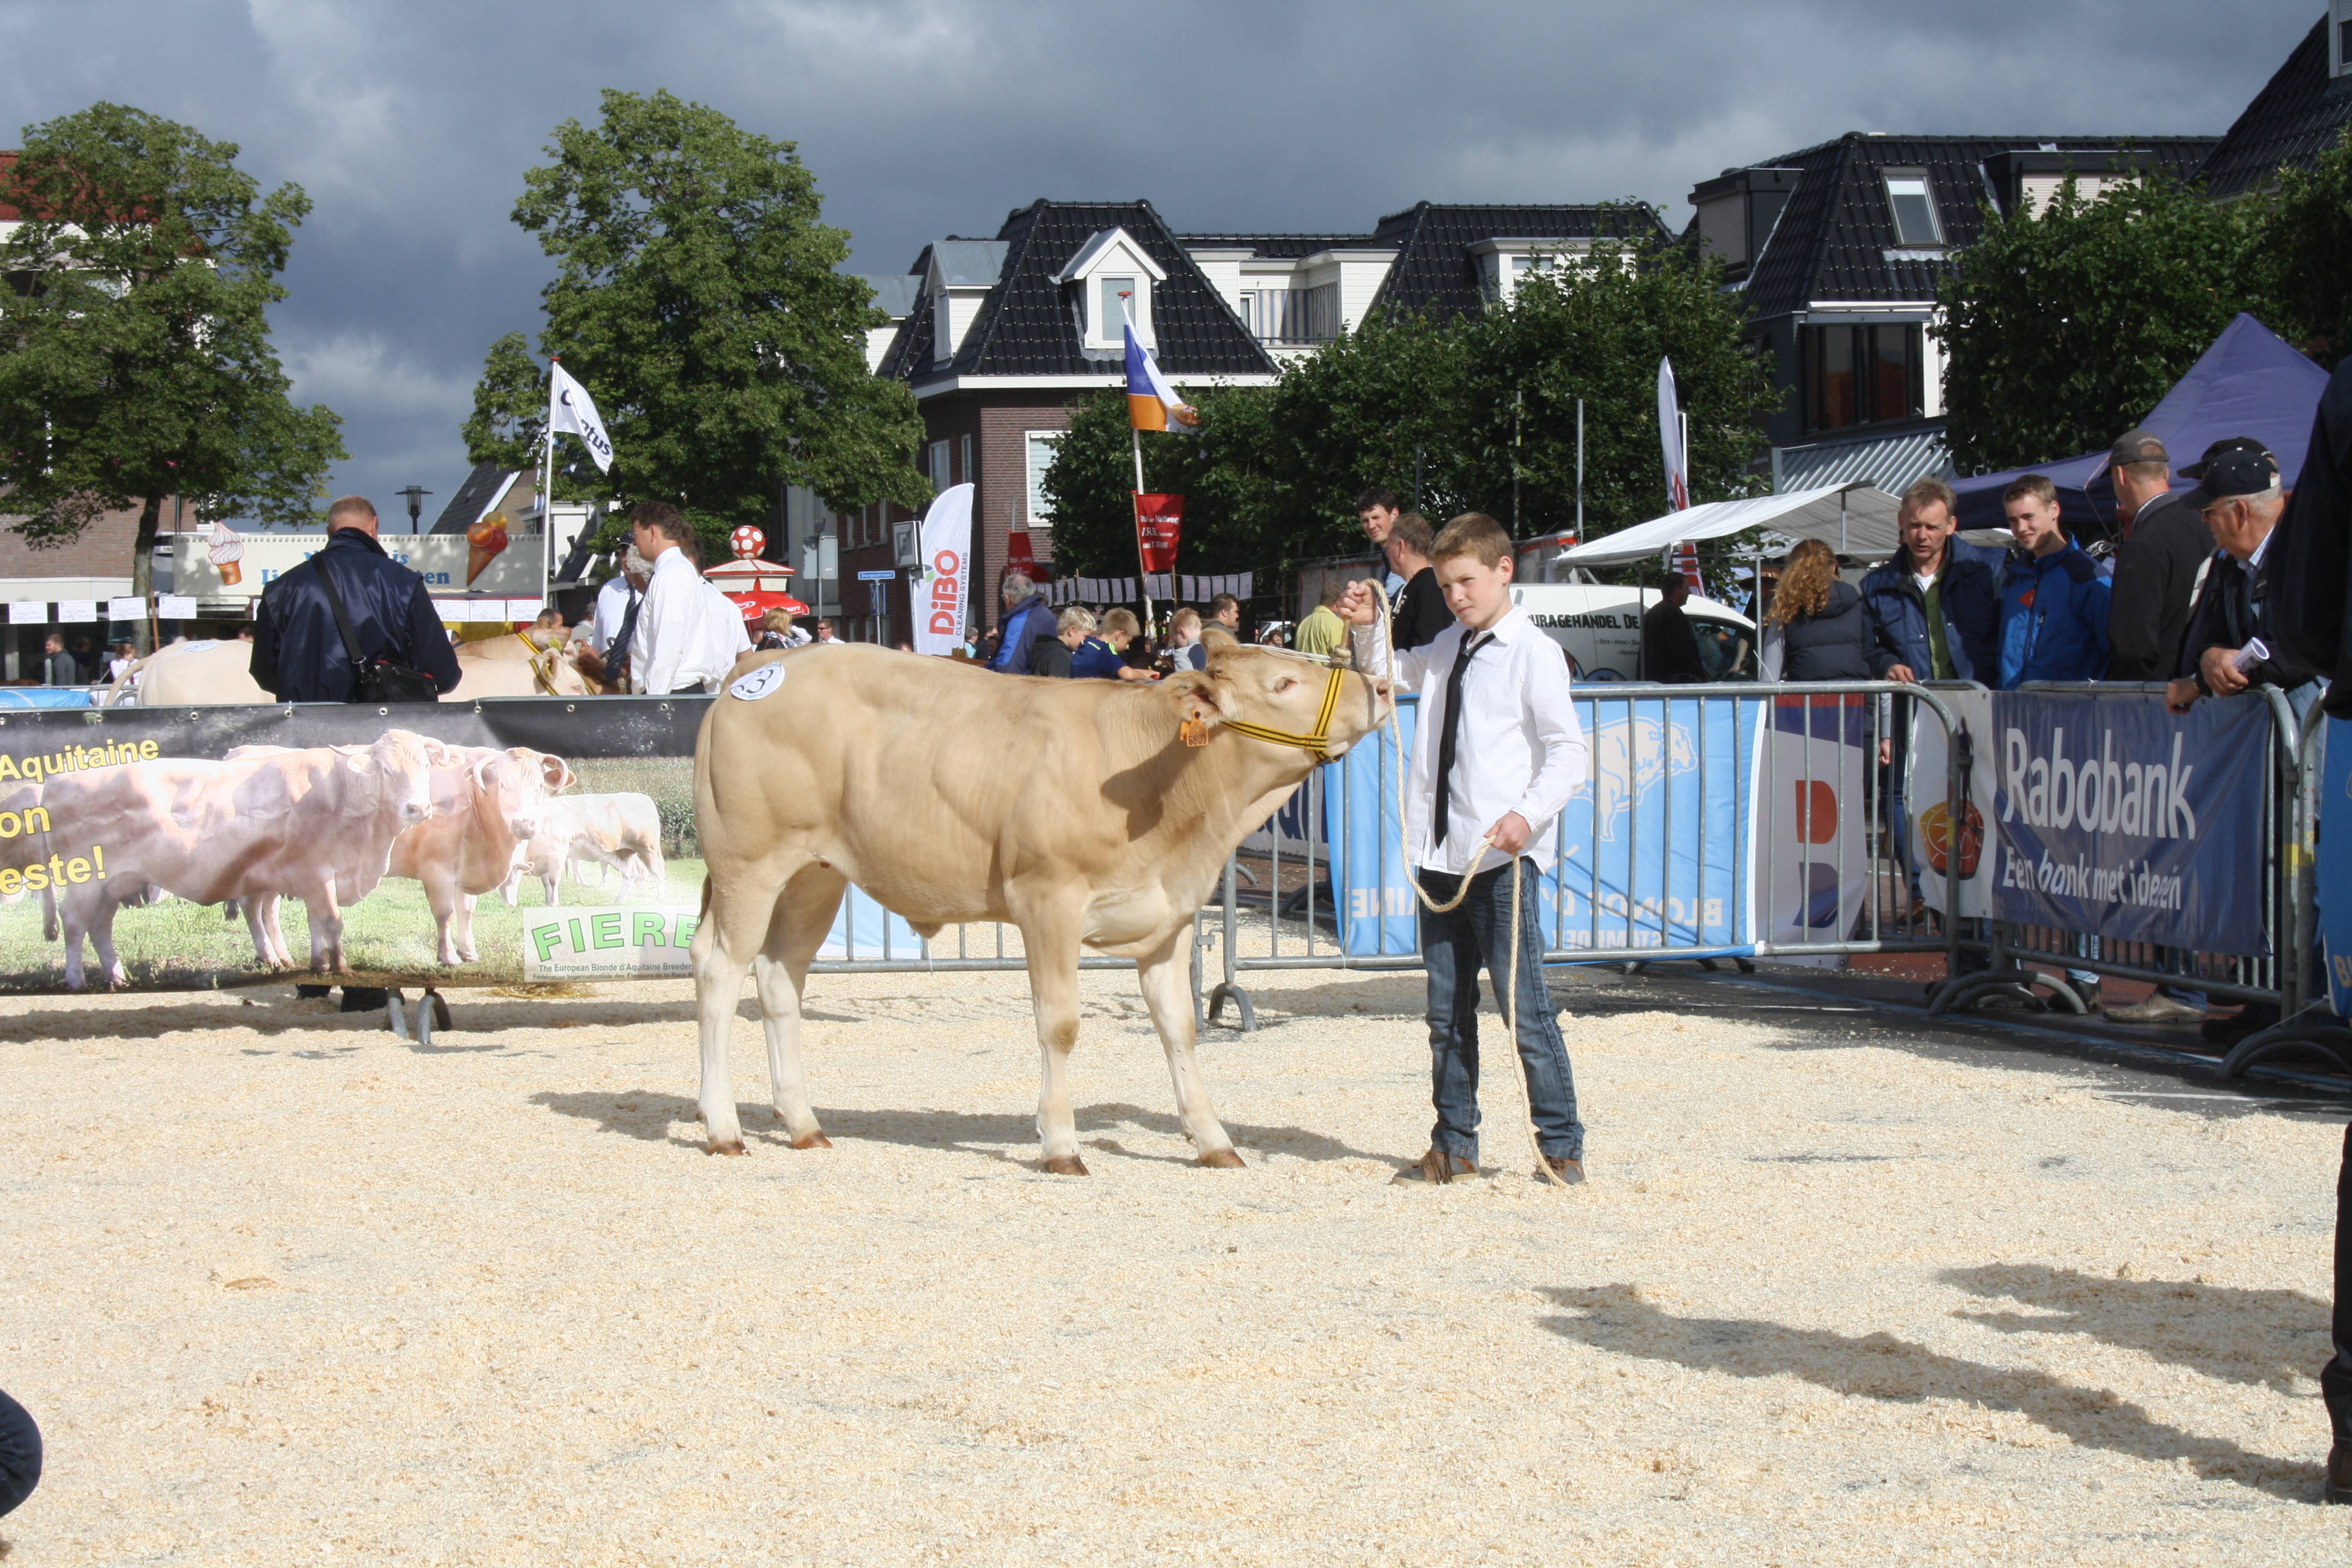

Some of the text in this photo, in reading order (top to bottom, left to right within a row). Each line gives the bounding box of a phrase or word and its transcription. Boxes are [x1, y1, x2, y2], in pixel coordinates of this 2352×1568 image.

[956, 593, 965, 636] CLEANING
[1528, 613, 1621, 629] URAGEHANDEL
[0, 739, 158, 783] Aquitaine
[2002, 727, 2195, 840] Rabobank
[2002, 846, 2035, 890] Een
[2037, 849, 2089, 899] bank
[2092, 864, 2126, 904] met
[554, 964, 589, 973] European
[591, 963, 617, 972] Blonde
[619, 963, 661, 972] d'Aquitaine
